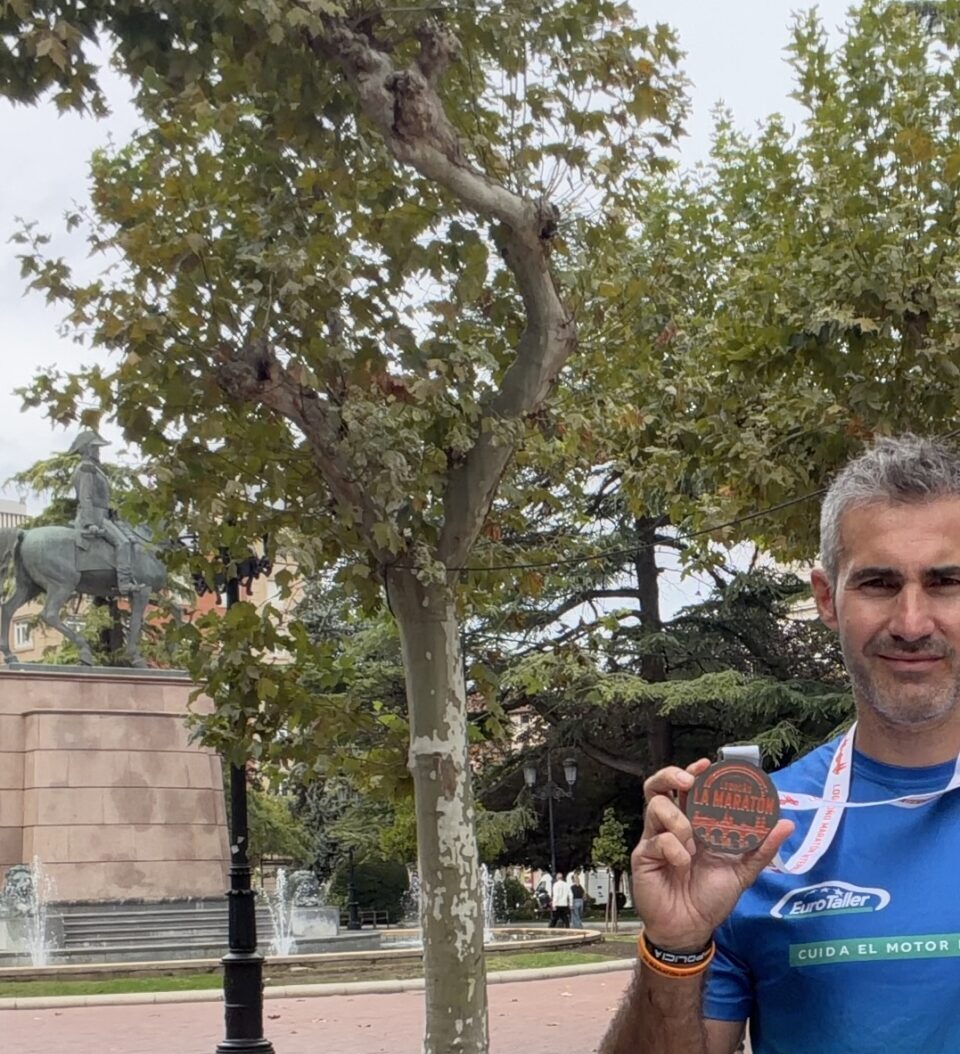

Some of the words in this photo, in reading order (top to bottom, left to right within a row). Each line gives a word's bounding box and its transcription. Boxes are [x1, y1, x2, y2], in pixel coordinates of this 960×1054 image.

[693, 787, 709, 806] LA
[788, 891, 870, 916] EuroTaller
[798, 944, 850, 961] CUIDA
[858, 943, 877, 955] EL
[886, 940, 949, 954] MOTOR
